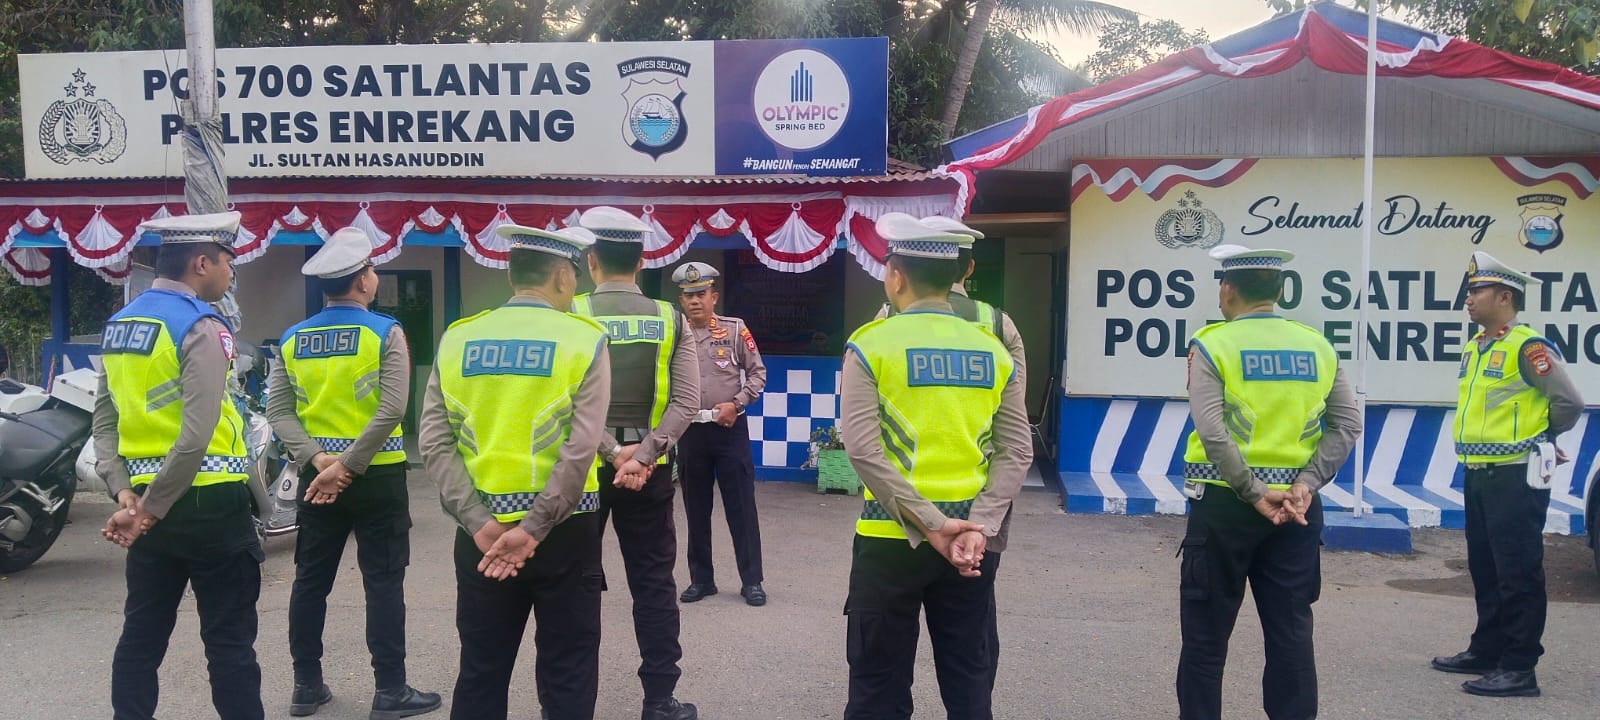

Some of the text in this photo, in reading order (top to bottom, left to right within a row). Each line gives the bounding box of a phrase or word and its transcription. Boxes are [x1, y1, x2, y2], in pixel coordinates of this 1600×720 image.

[621, 60, 687, 74] SULAWESI SELATAN
[235, 64, 313, 98] 700
[323, 61, 591, 98] SATLANTAS
[762, 105, 839, 121] OLYMPIC
[161, 109, 575, 145] PLRES ENREKANG
[808, 123, 826, 131] BED
[248, 152, 485, 168] JL. SULTAN HASANUDDIN
[743, 157, 793, 170] #BANGUN
[810, 158, 860, 169] SEMANGAT
[1240, 194, 1497, 245] Selamat Datang
[1096, 268, 1196, 309] POS
[298, 331, 356, 354] POLISI
[465, 344, 551, 369] POLISI
[912, 353, 990, 381] POLISI
[1245, 354, 1315, 376] POLISI
